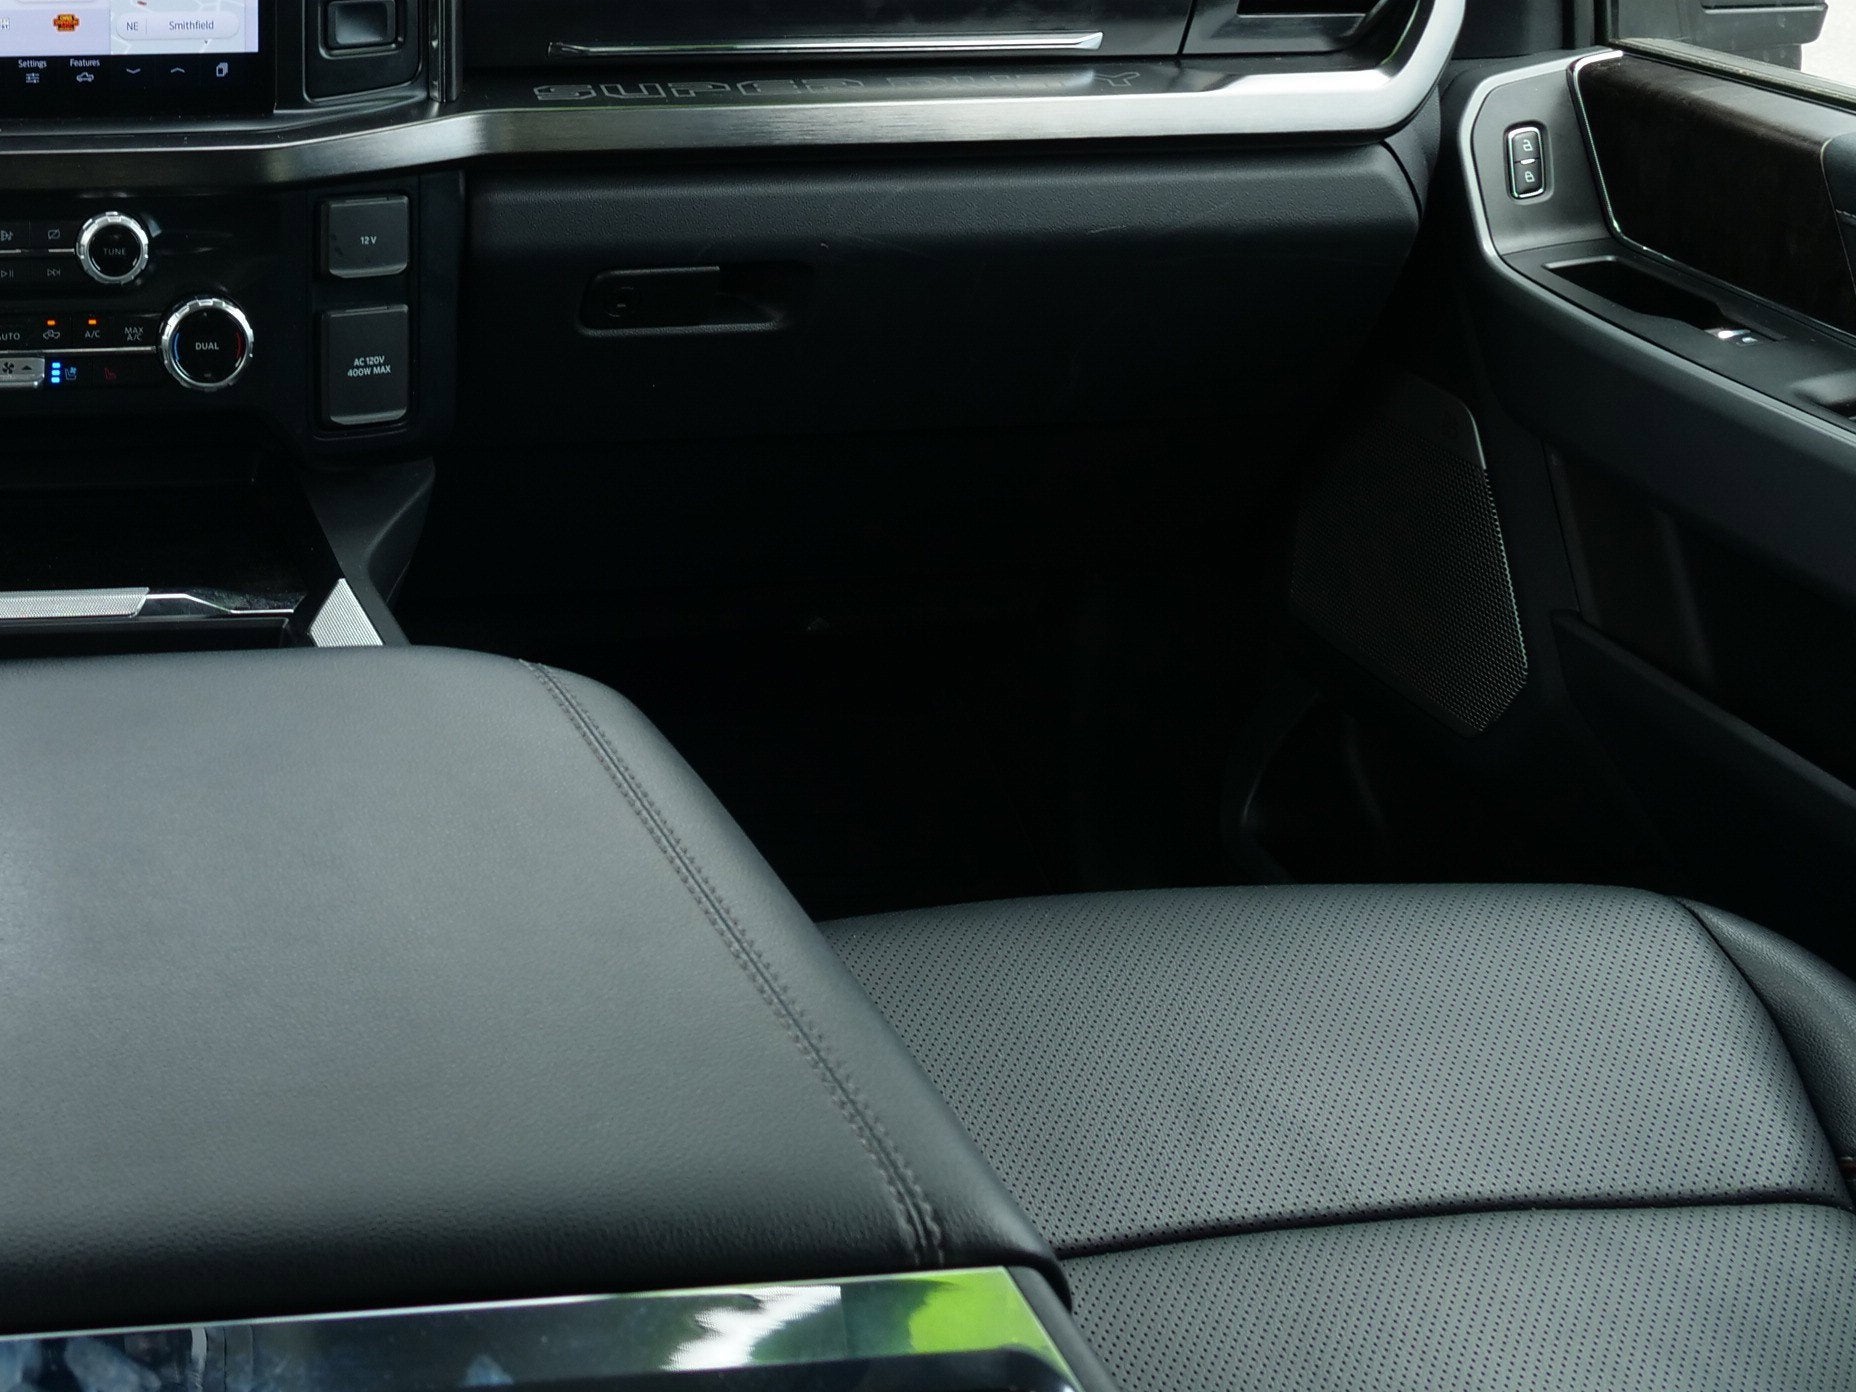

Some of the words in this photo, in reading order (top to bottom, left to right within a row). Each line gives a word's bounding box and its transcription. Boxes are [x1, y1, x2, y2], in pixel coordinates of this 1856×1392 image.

[126, 21, 139, 32] NE
[169, 20, 215, 31] Smithfield
[18, 59, 47, 70] Settings
[69, 58, 101, 68] Features
[533, 77, 865, 102] SUPER
[360, 236, 370, 245] 12
[103, 247, 126, 256] TUNE
[84, 330, 101, 339] A/C
[124, 326, 144, 334] MAX
[127, 332, 143, 342] A/C
[195, 341, 220, 351] DUAL
[353, 357, 366, 367] AC
[366, 355, 386, 366] 120V
[347, 367, 372, 378] 400W
[372, 364, 392, 375] MAX
